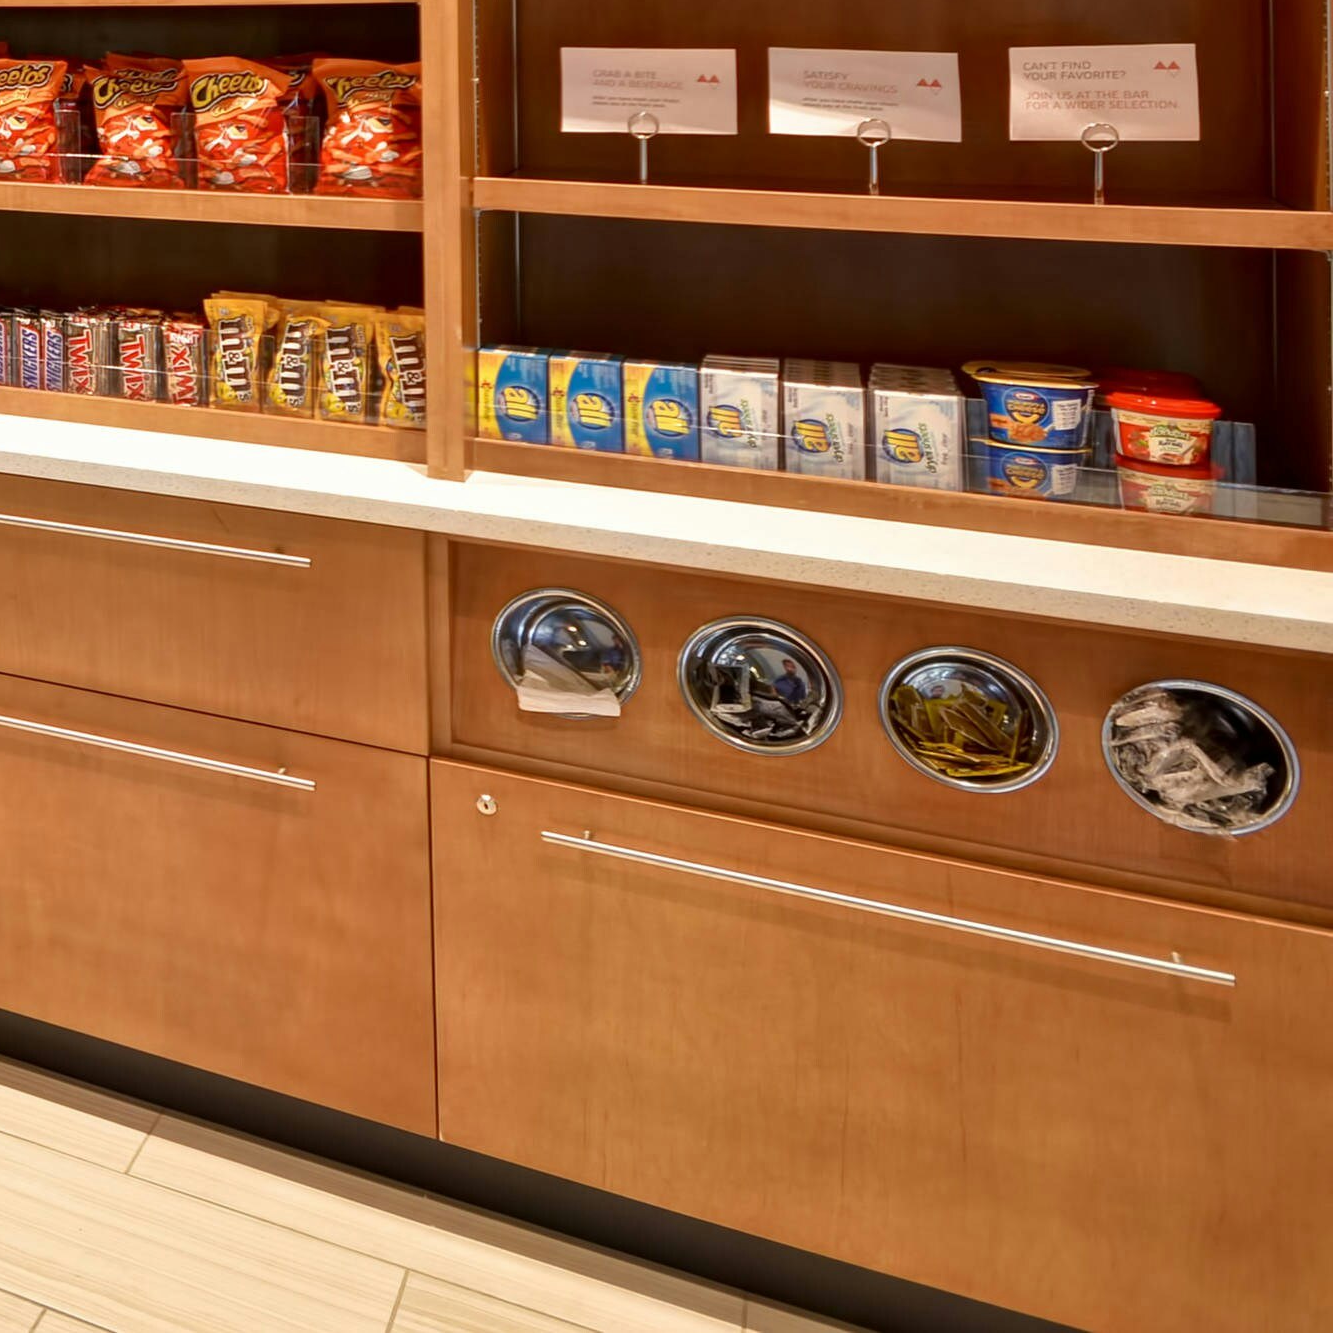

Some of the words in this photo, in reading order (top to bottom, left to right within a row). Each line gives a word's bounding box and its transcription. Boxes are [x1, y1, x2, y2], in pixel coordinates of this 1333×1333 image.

[623, 70, 632, 78] A
[804, 70, 849, 81] SATISFY
[1022, 62, 1057, 72] CAN'T
[1061, 61, 1092, 71] FIND
[1023, 71, 1058, 82] YOUR
[1060, 70, 1127, 81] FAVORITE?
[804, 80, 836, 91] YOUR
[839, 82, 898, 95] CRAVINGS
[1026, 90, 1054, 101] JOIN
[1057, 90, 1074, 100] US
[1076, 90, 1091, 100] AT
[1095, 90, 1119, 99] THE
[1123, 90, 1150, 100] BAR
[1025, 100, 1050, 110] FOR
[1052, 100, 1065, 110] A
[1065, 100, 1106, 110] WIDER
[21, 328, 40, 390] SNICKERS
[44, 330, 63, 392] SNICKERS
[68, 328, 94, 395] TWIX
[119, 333, 145, 402] TWIX
[169, 345, 198, 406] TWIX
[504, 386, 540, 421] all
[575, 393, 613, 428] all
[652, 399, 692, 436] all
[709, 406, 743, 438] all
[795, 420, 831, 453] all
[885, 429, 924, 463] all
